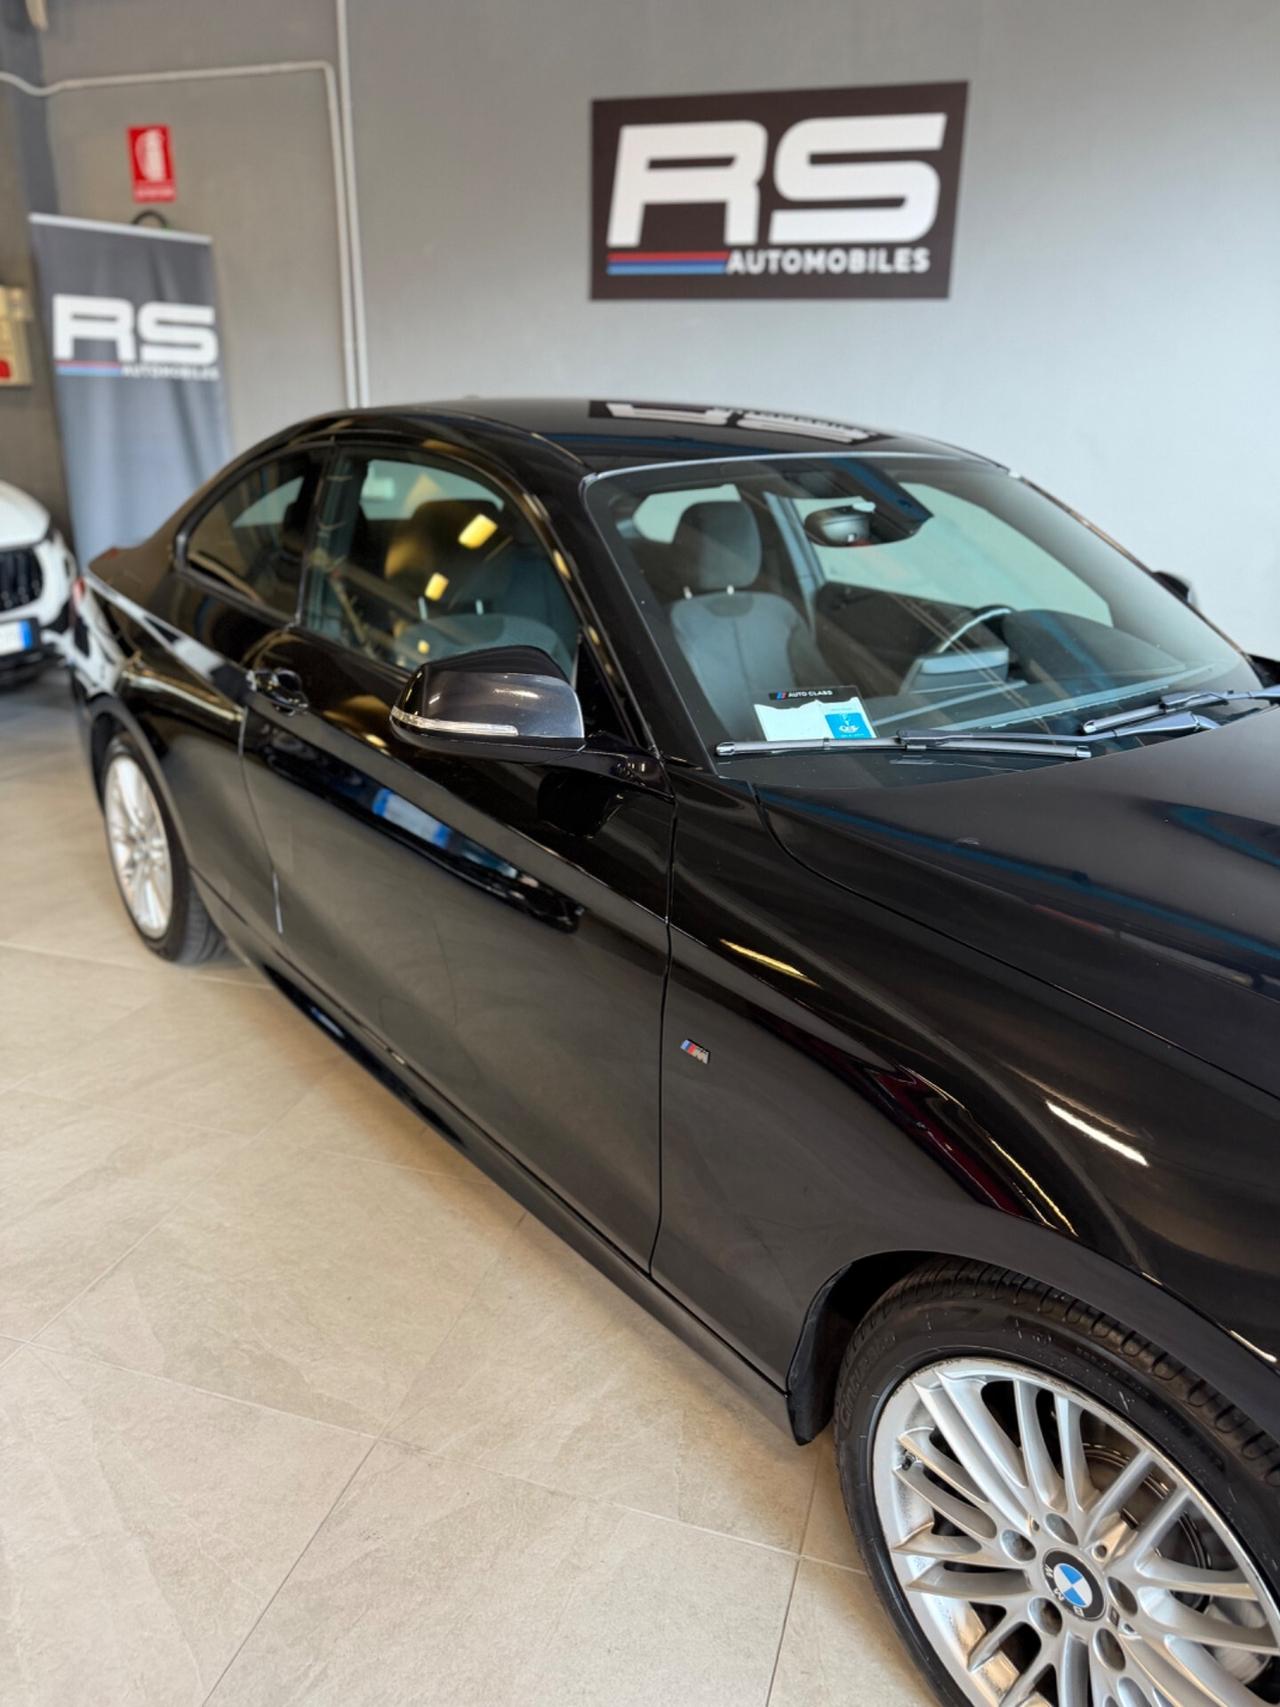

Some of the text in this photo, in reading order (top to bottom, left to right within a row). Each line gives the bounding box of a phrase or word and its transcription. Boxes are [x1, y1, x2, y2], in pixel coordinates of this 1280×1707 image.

[607, 112, 947, 247] RS
[725, 247, 931, 275] AUTOMOBILES
[53, 293, 218, 366] RS
